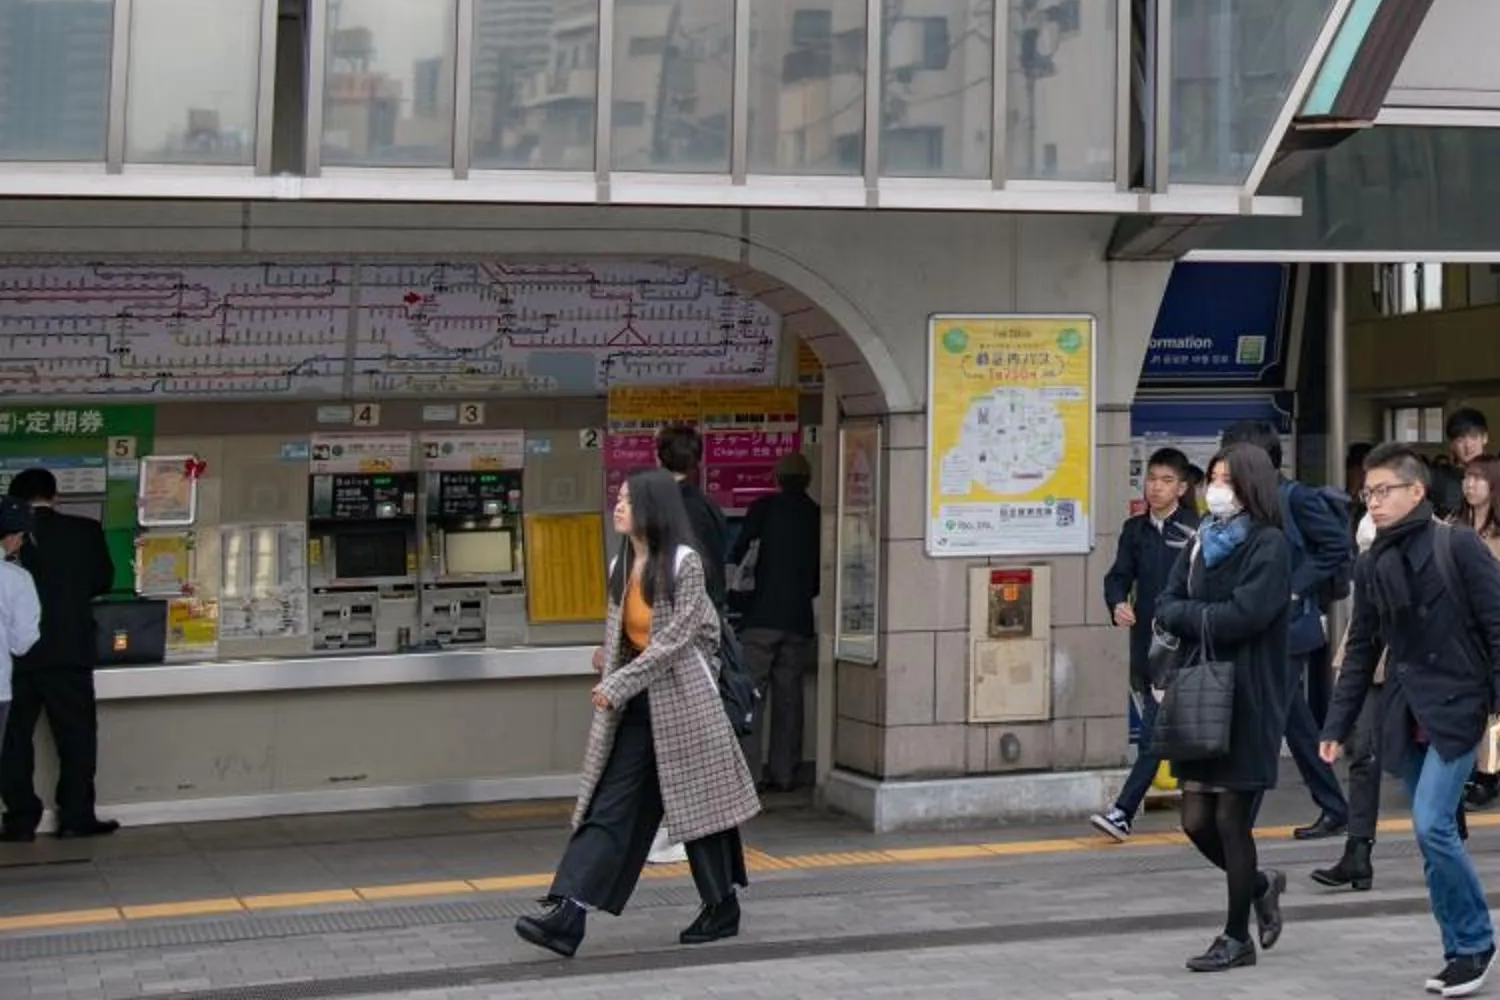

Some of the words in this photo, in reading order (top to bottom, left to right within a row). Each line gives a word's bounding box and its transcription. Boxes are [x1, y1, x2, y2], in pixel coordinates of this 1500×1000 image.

[359, 405, 372, 424] 4
[464, 405, 479, 423] 3
[585, 430, 598, 447] 2
[114, 439, 129, 457] 5
